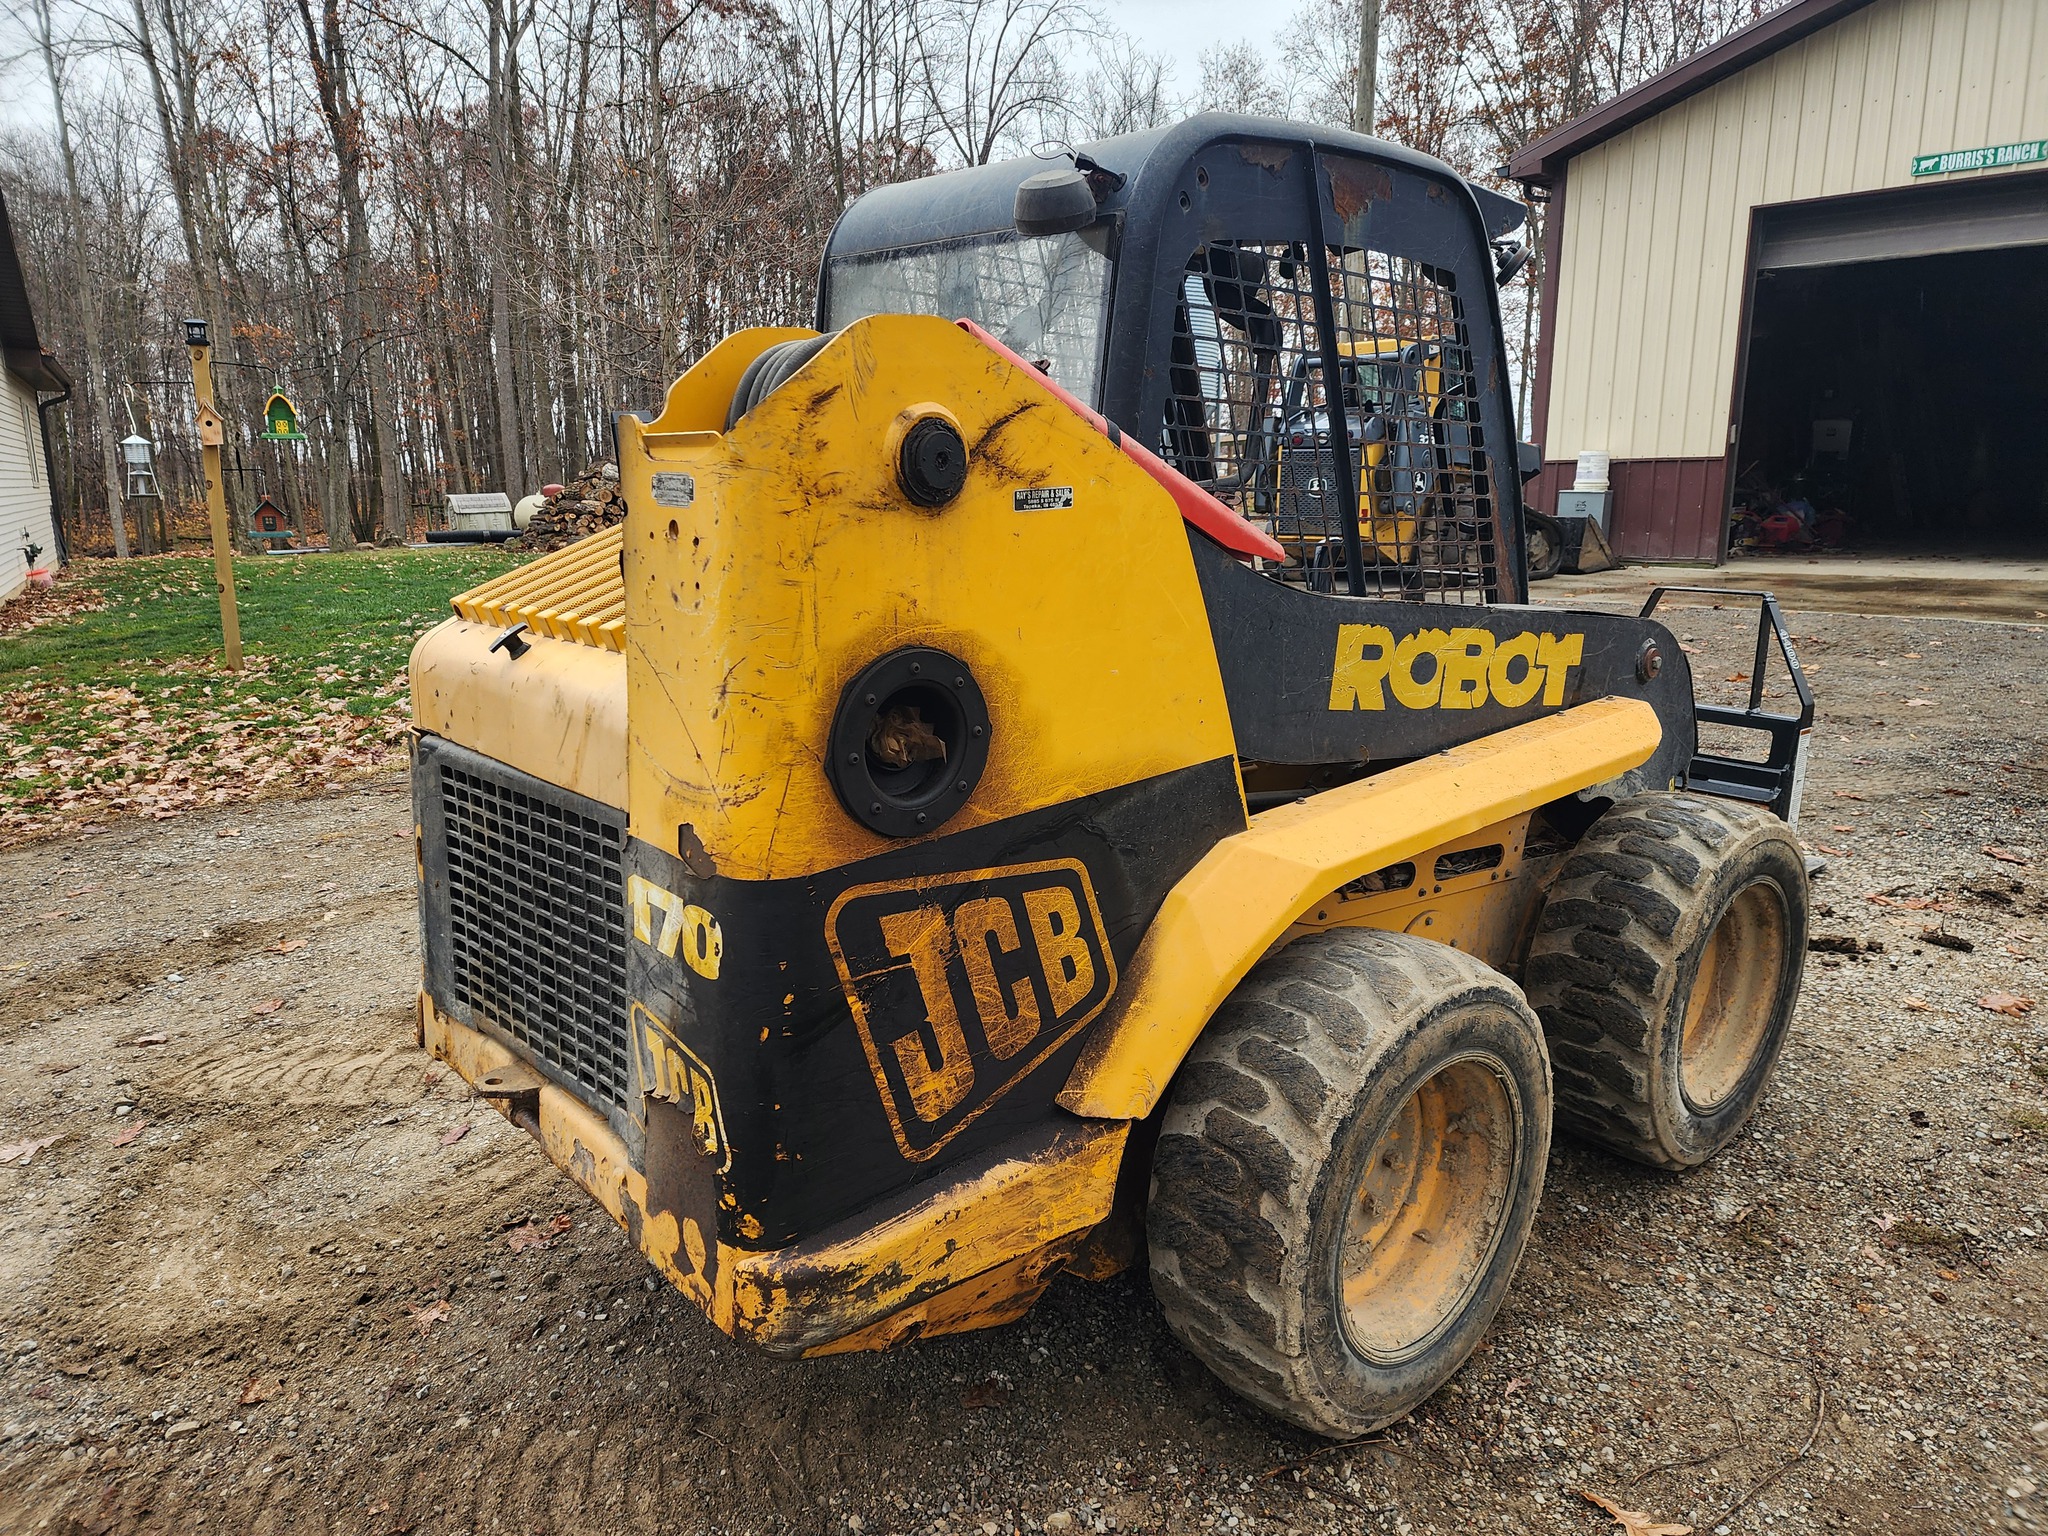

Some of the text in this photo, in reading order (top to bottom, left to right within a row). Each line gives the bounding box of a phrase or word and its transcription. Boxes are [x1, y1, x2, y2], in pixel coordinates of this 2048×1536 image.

[1940, 142, 2040, 171] BURRIS'S RANCH
[1016, 491, 1031, 500] RAY'S
[1032, 489, 1049, 499] REPAIR
[1050, 489, 1055, 498] &
[1328, 623, 1585, 710] ROBOT
[1780, 628, 1800, 670] 4400
[627, 873, 723, 980] 170
[878, 886, 1096, 1122] JCB
